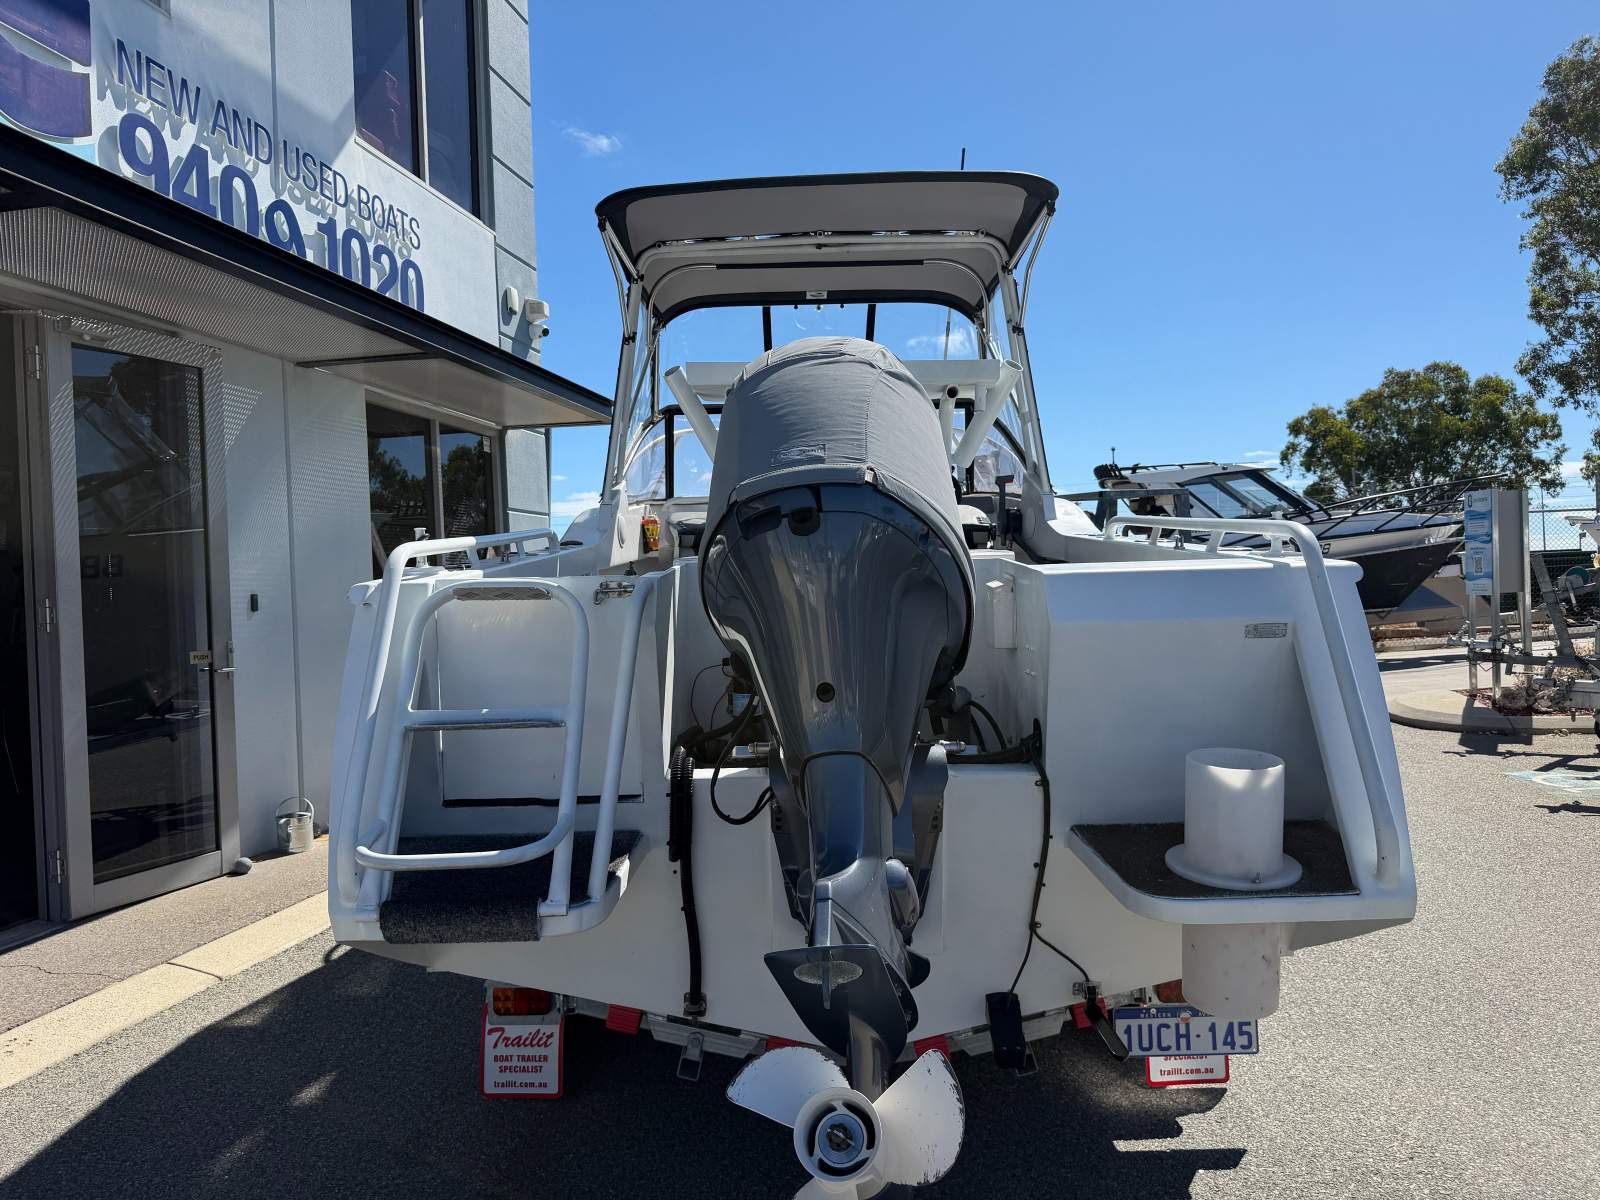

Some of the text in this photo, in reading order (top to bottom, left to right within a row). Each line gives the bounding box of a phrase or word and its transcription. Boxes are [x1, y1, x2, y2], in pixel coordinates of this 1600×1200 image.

[116, 38, 420, 250] NEW AND USED BOATS
[487, 1026, 554, 1049] Trailit
[493, 1054, 549, 1063] BOAT TRAILER
[498, 1065, 543, 1073] SPECIALIST
[1159, 1067, 1215, 1076] trailit.com.au
[493, 1080, 548, 1089] trailit.com.au
